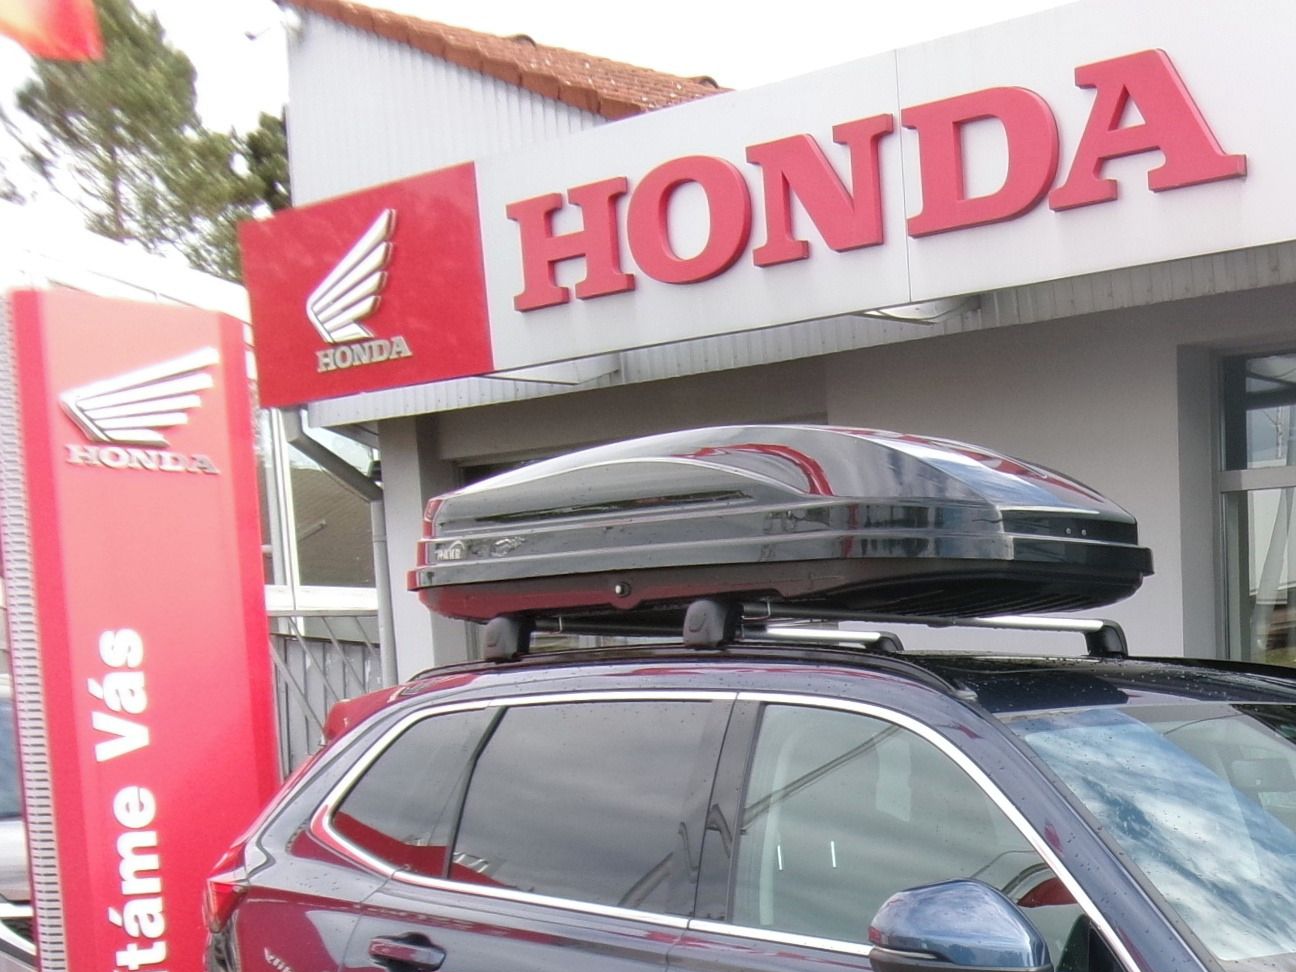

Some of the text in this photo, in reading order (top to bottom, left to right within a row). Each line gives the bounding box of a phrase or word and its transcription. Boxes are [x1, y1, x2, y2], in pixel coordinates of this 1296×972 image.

[506, 48, 1247, 313] HONDA
[315, 335, 413, 373] HONDA
[65, 443, 220, 475] HONDA
[87, 626, 151, 763] Vás
